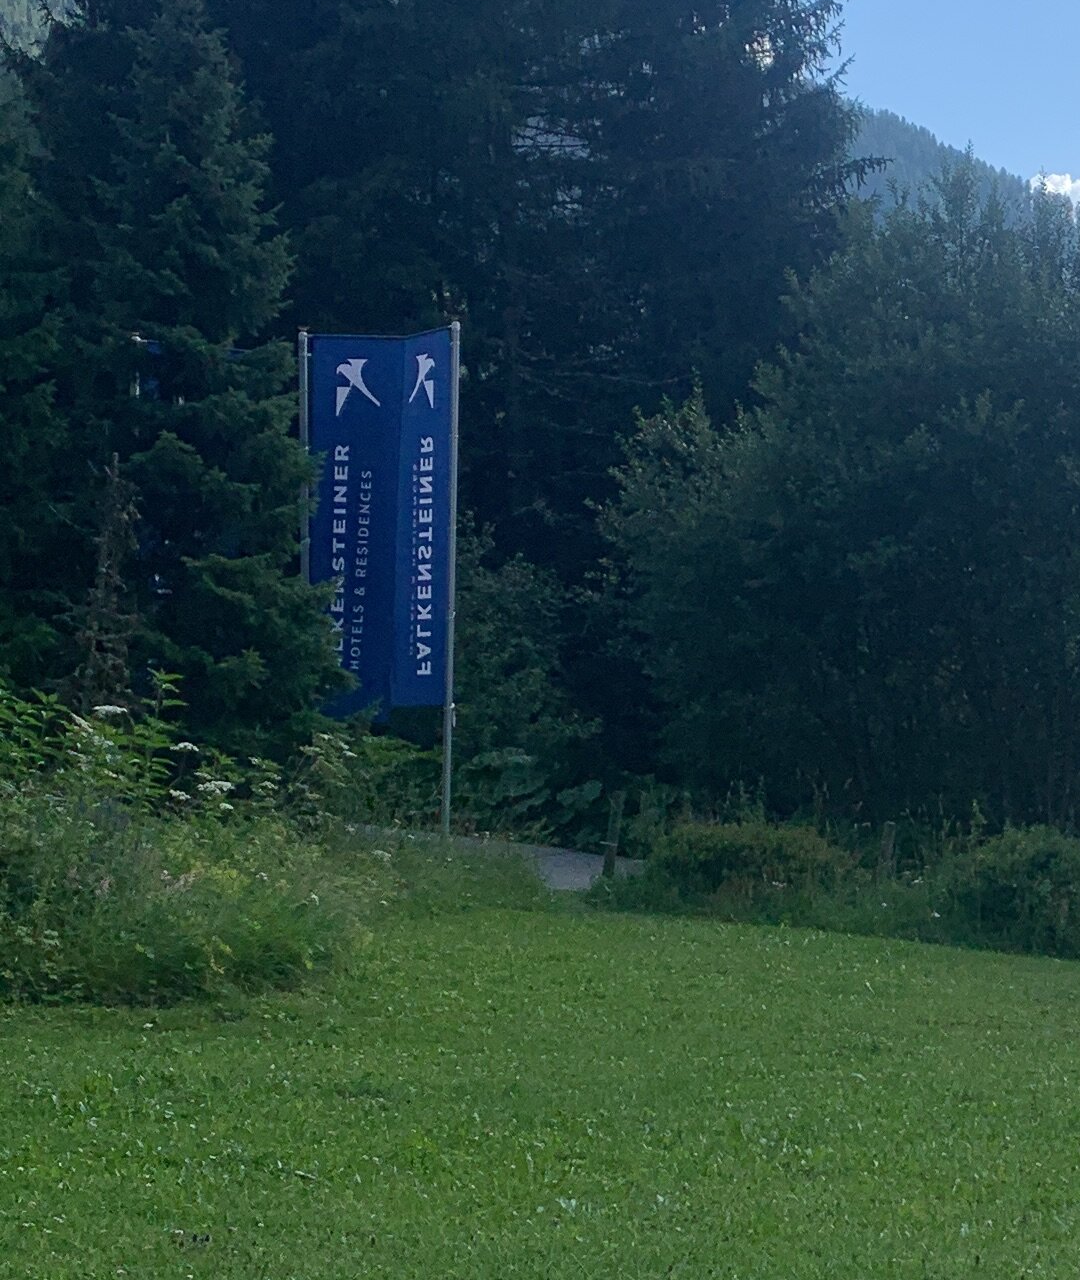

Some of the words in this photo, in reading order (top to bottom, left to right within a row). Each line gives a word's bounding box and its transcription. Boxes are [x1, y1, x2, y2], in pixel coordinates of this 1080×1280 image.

[330, 445, 350, 667] LKENSTEINER
[355, 470, 372, 578] RESIDENCES
[353, 586, 366, 596] &
[350, 604, 365, 670] HOTELS
